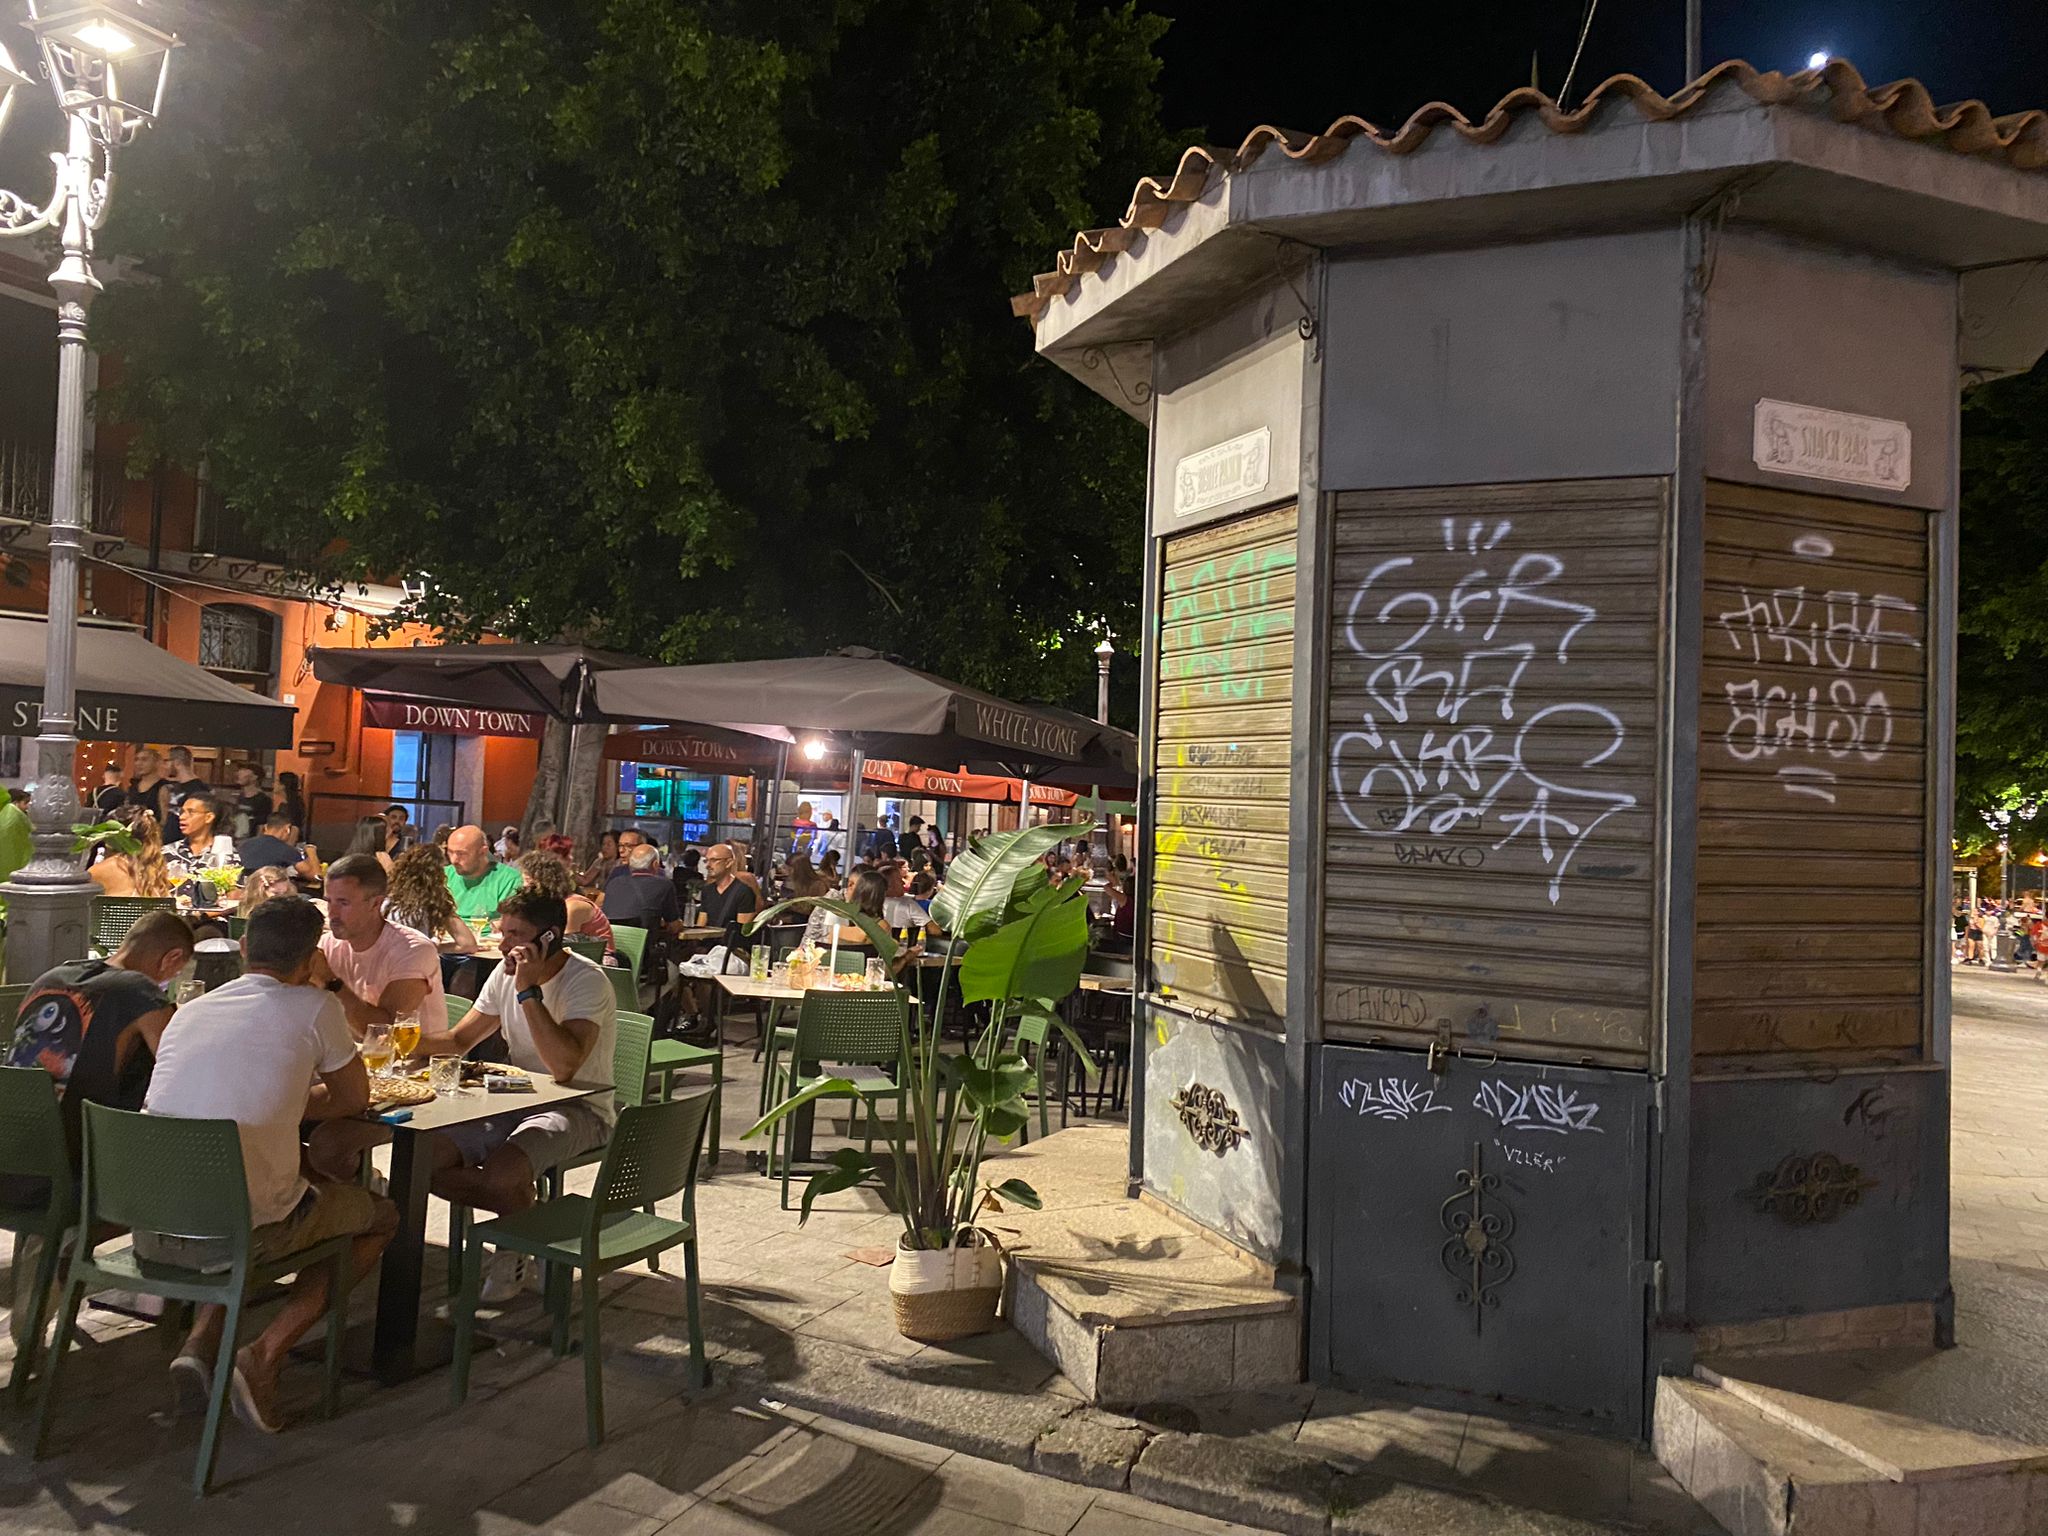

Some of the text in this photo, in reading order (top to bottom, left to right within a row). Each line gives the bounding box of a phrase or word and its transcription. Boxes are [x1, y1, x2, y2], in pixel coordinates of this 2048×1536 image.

[13, 701, 118, 732] STNE
[405, 704, 531, 732] DOWN TOWN
[976, 703, 1078, 756] WHITE STONE
[642, 740, 737, 760] DOWN TOWN
[926, 775, 964, 793] OWN
